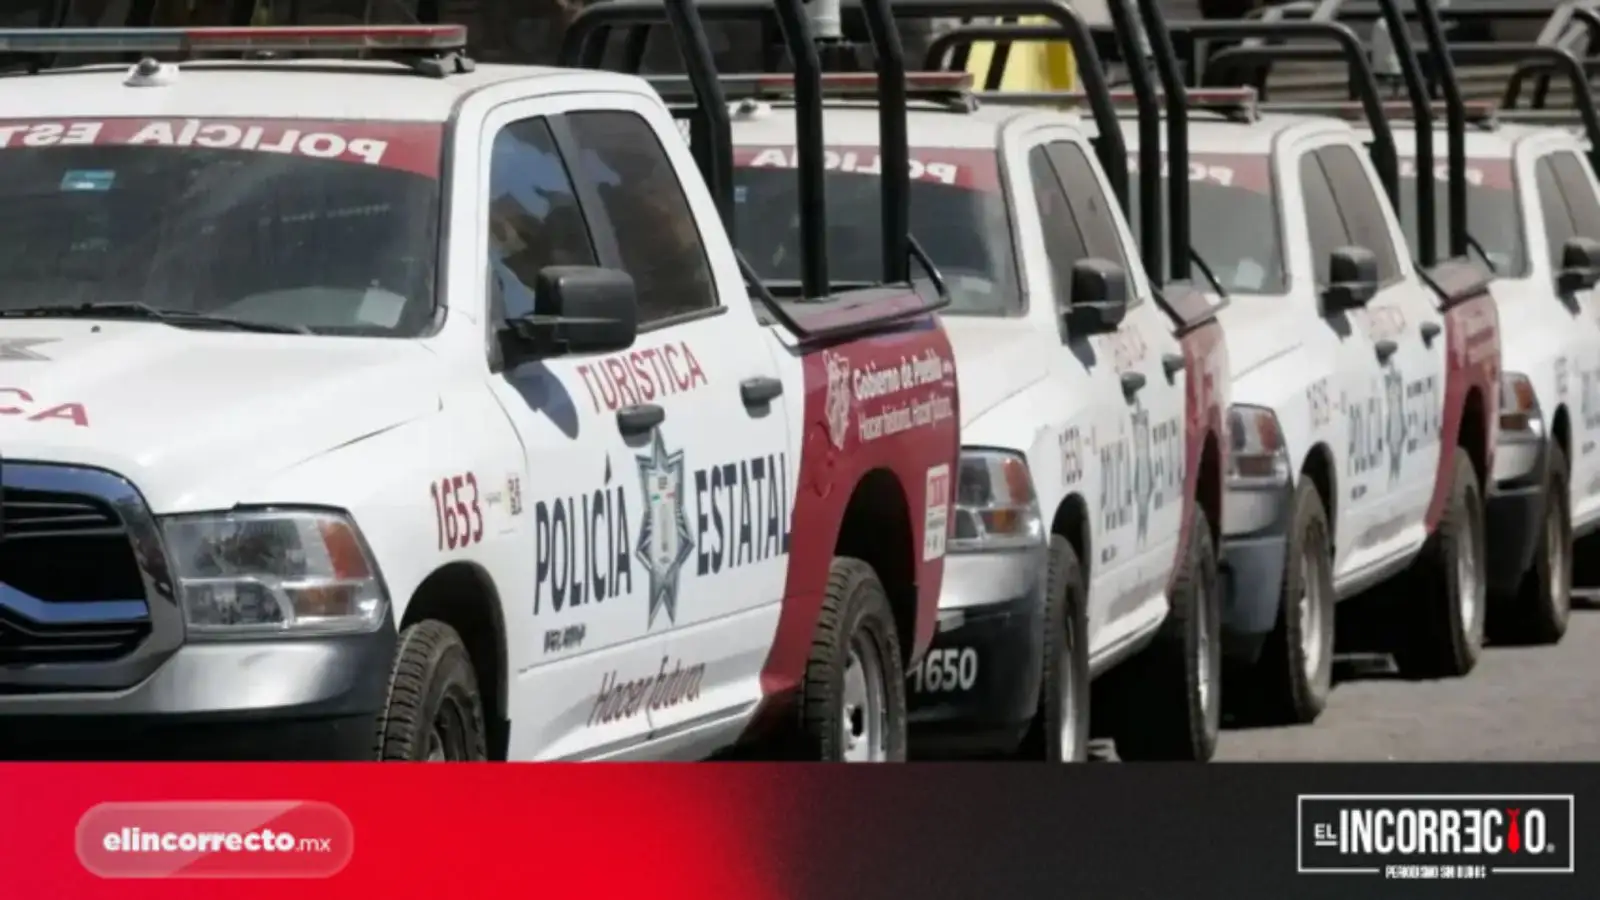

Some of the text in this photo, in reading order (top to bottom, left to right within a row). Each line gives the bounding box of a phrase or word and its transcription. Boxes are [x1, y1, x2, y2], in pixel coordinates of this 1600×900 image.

[430, 471, 484, 552] 1653
[533, 449, 633, 616] POLICÍA
[693, 452, 792, 577] ESTATAL
[905, 646, 978, 694] 1650
